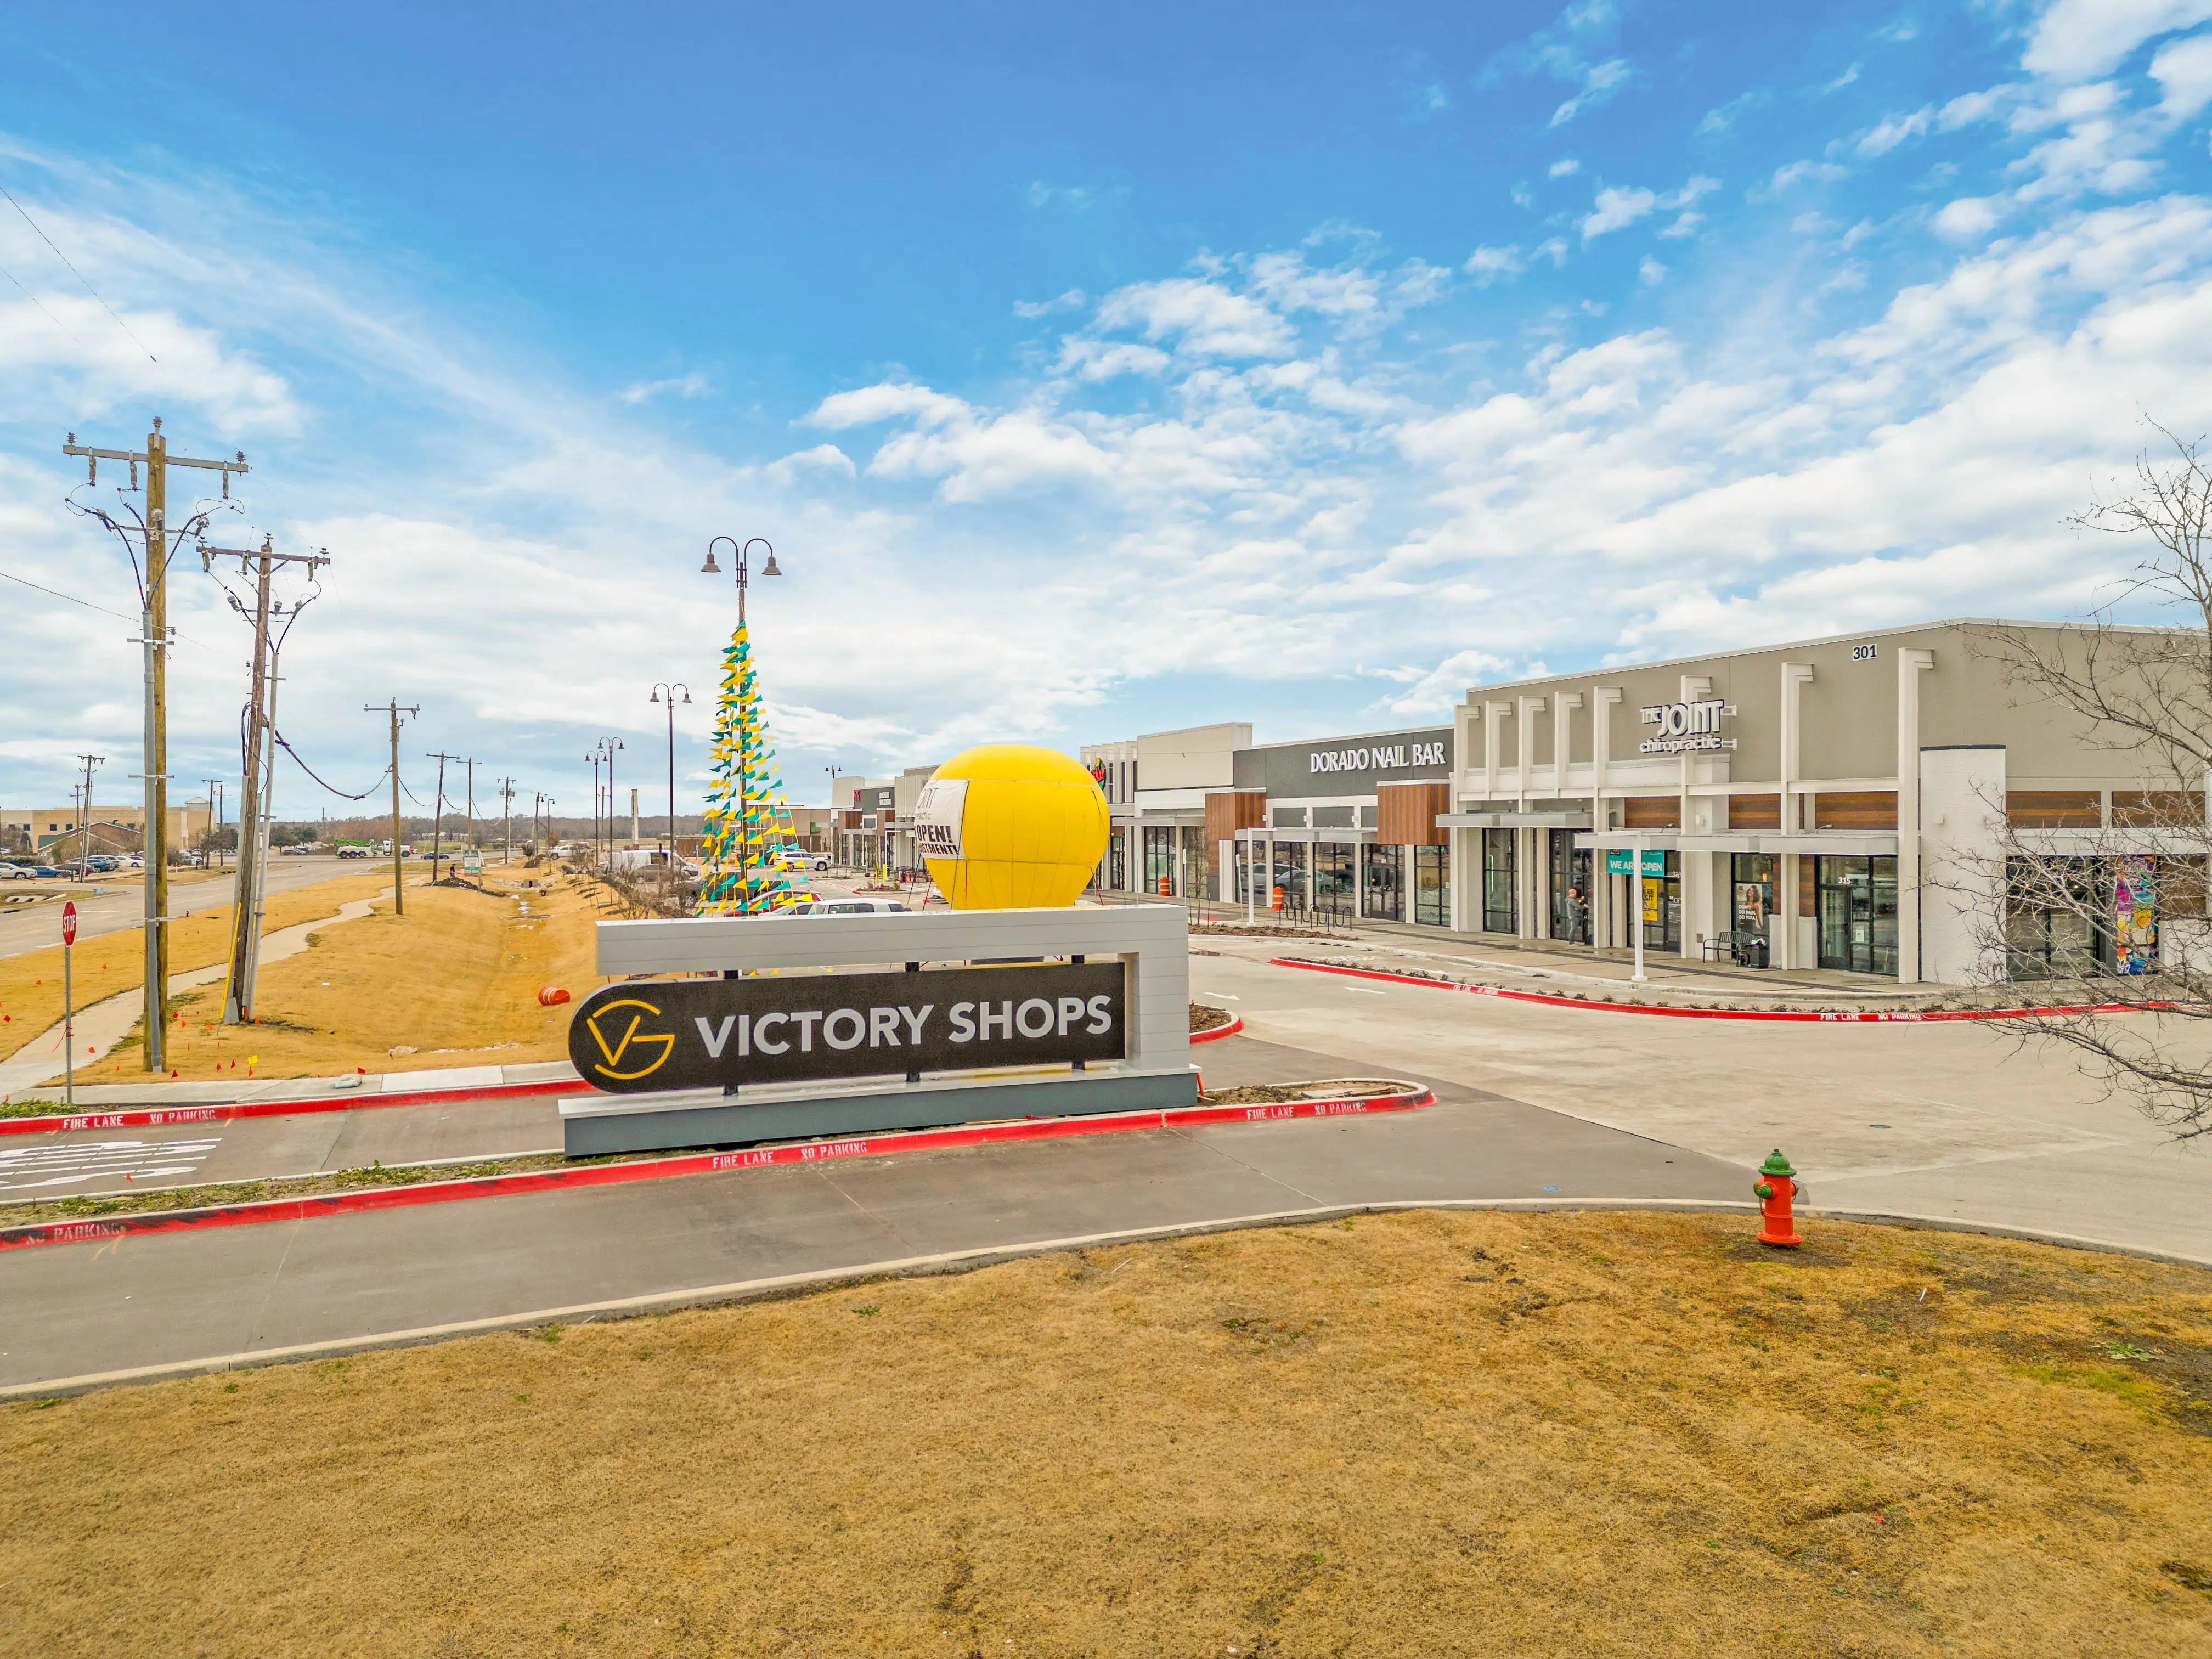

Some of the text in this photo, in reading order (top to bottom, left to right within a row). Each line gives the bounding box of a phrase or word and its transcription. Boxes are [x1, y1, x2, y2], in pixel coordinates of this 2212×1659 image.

[1853, 645, 1877, 659] 301
[1657, 700, 1724, 736] JOINT
[1640, 735, 1722, 753] chiropractic
[1311, 742, 1446, 772] DORADO NAIL BAR
[917, 824, 953, 843] OPEN!
[1610, 860, 1662, 871] WE AR OPEN
[63, 914, 75, 933] STOP
[695, 995, 1111, 1058] VICTORY SHOPS
[63, 1109, 217, 1130] FIRE LANE NO PARKING
[1247, 1102, 1367, 1120] FIRE LANE NO PARKING
[713, 1142, 867, 1169] FIRE LANE NO PARKING
[54, 1222, 120, 1240] PARKING
